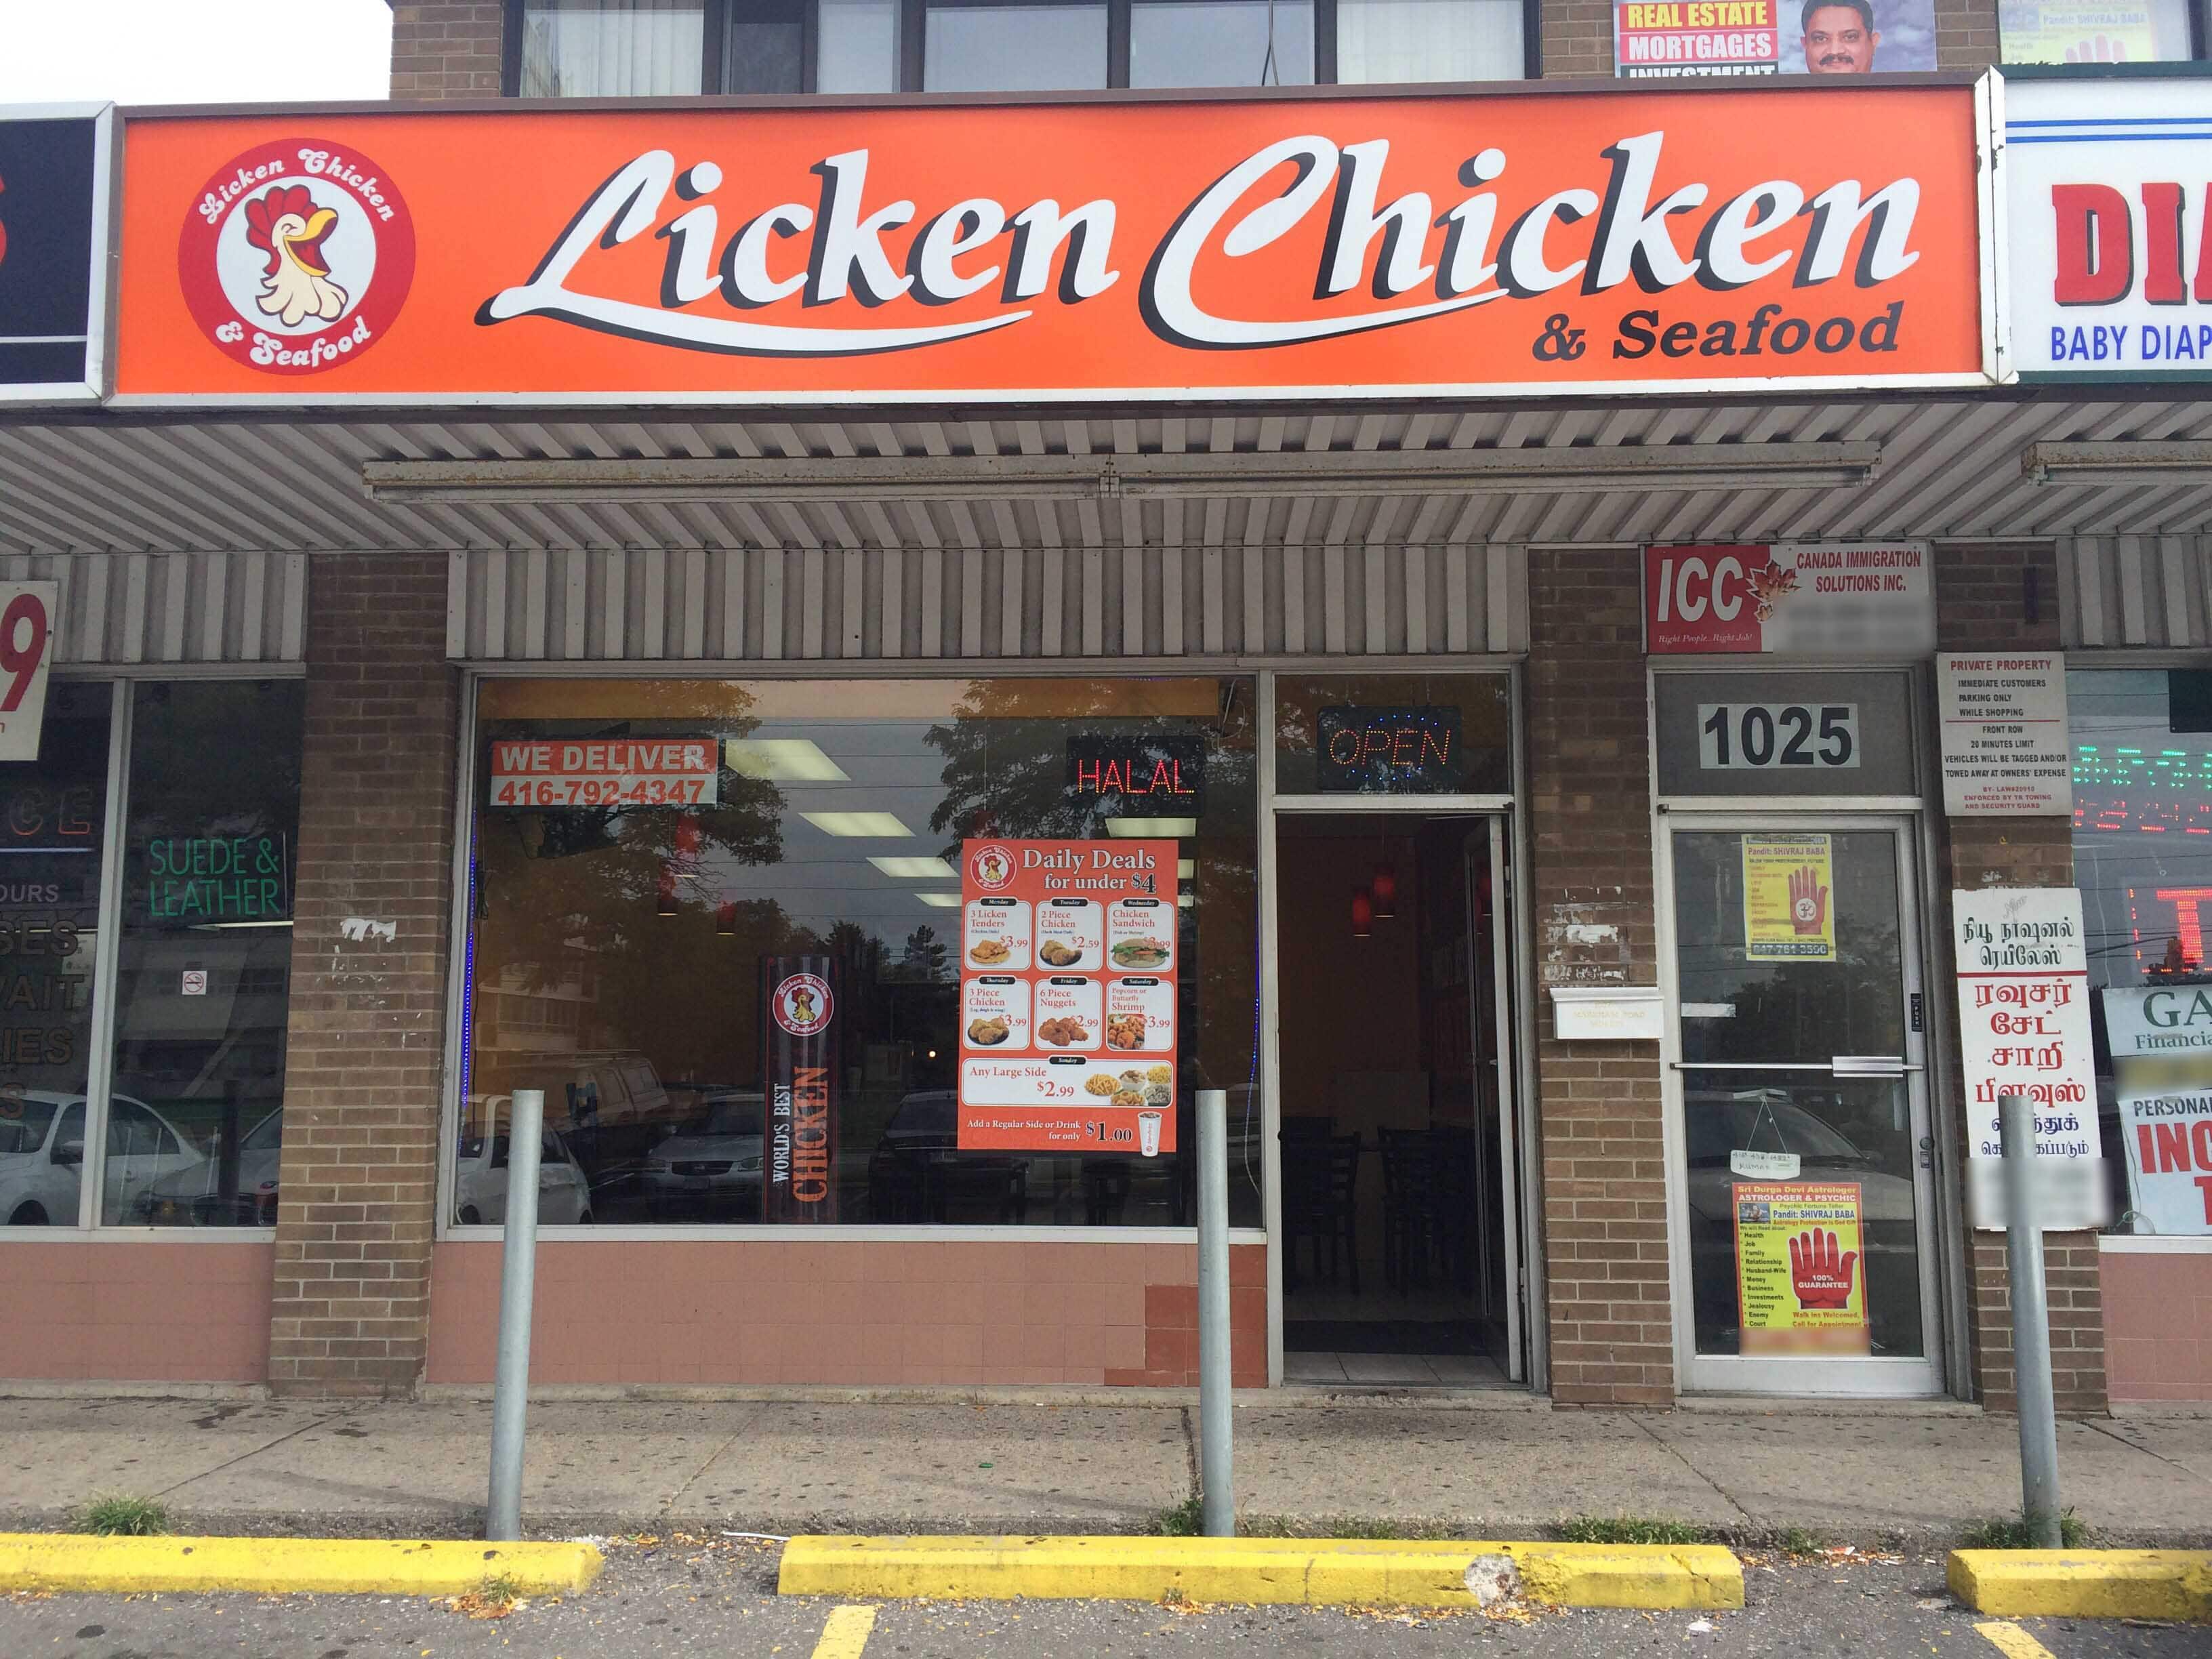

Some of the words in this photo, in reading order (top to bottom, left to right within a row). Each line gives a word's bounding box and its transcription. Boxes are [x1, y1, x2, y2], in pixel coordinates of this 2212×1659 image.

[1628, 5, 1682, 28] REAL
[1688, 3, 1767, 26] ESTATE
[1629, 33, 1771, 60] MORTGAGES
[199, 159, 285, 224] Licken
[298, 148, 394, 222] Chicken
[474, 148, 1120, 358] Licken
[1138, 130, 1921, 351] Chicken
[2052, 182, 2212, 306] DI
[250, 316, 371, 367] Seafood
[1533, 314, 1586, 362] &
[1613, 302, 1904, 359] Seafood
[2051, 326, 2128, 361] BABY
[2142, 325, 2212, 360] DIAP
[1797, 552, 1843, 569] CANADA
[1846, 551, 1921, 568] IMMIGRATION
[1658, 556, 1744, 621] ICC
[1816, 575, 1881, 592] SOLUTIONS
[1884, 575, 1906, 592] INC.
[0, 594, 47, 712] 9
[1950, 661, 1993, 671] PRIVATE
[1996, 660, 2051, 670] PROPERTY
[1330, 729, 1451, 766] OPEN
[1705, 706, 1852, 766] 1025
[1971, 740, 1979, 748] 20
[1982, 740, 2013, 748] MINUTES
[501, 747, 550, 771] WE
[562, 745, 705, 771] DELIVER
[1944, 755, 1979, 763] VEHICLES
[1078, 759, 1195, 794] HALAL
[498, 780, 705, 806] 416-792-4347
[150, 838, 247, 876] SUEDE
[255, 838, 279, 874] &
[1023, 848, 1086, 875] Daily
[1091, 849, 1155, 869] Deals
[1044, 873, 1070, 889] for
[1074, 874, 1127, 889] under
[1131, 872, 1156, 895] $4
[150, 878, 281, 917] LEATHER
[970, 919, 1005, 927] Tenders
[1041, 920, 1076, 928] Chicken
[1049, 910, 1071, 918] Piece
[1113, 909, 1149, 918] Chicken
[1113, 919, 1155, 927] Sandwich
[1000, 935, 1028, 947] $3.99
[0, 974, 85, 1010] AIT
[970, 998, 1005, 1006] Chicken
[977, 988, 1000, 996] Piece
[1040, 989, 1046, 997] 6
[1048, 989, 1071, 997] Piece
[1040, 998, 1076, 1008] Nuggets
[1112, 1002, 1145, 1013] Shrimp
[2143, 989, 2212, 1027] GA
[970, 1067, 990, 1078] Any
[994, 1067, 1022, 1078] Large
[1025, 1067, 1046, 1076] Side
[774, 1083, 791, 1117] BEST
[1037, 1081, 1074, 1097] $2.99
[2133, 1097, 2212, 1117] PERSONA
[792, 1067, 829, 1202] CHICKEN
[967, 1120, 984, 1128] Add
[992, 1120, 1023, 1129] Regular
[1056, 1120, 1081, 1128] Drink
[1063, 1132, 1081, 1141] only
[1086, 1121, 1132, 1142] $1.00
[773, 1122, 790, 1183] WORLD'S
